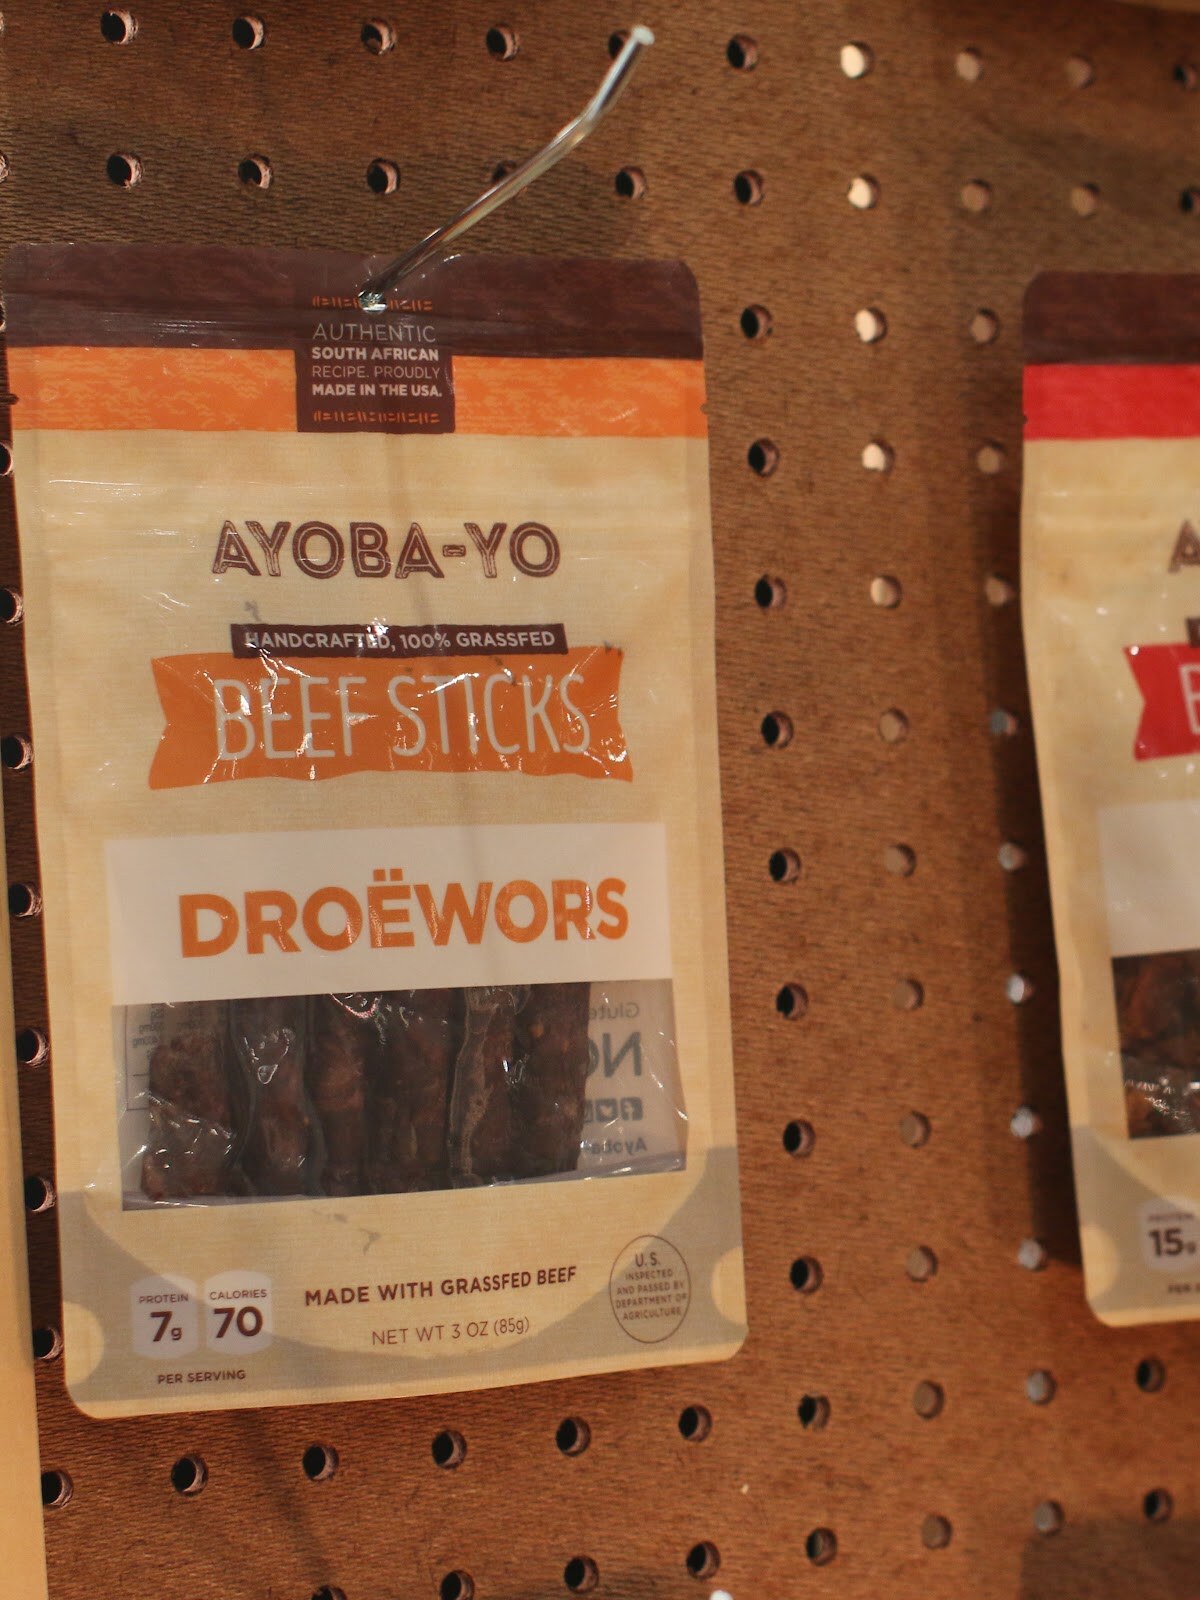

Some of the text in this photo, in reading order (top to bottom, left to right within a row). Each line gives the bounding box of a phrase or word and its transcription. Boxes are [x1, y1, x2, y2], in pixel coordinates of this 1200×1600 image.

[312, 323, 436, 343] AUTHENTIC
[312, 346, 439, 362] SOUTH AFRICAN
[312, 364, 441, 380] RECIPE. PROUDLY
[312, 383, 443, 398] MADE IN THE USA.
[211, 519, 562, 580] AYOBA-YO
[246, 631, 556, 652] HANDCRAFTED, 100% GRASSFED
[212, 673, 592, 761] BEEF STICKS
[178, 867, 631, 959] DROËWORS
[625, 1268, 674, 1281] INSPECTED
[304, 1265, 577, 1307] MADE WITH GRASSFED BEEF
[616, 1285, 635, 1295] AND
[638, 1281, 671, 1293] PASSED
[138, 1293, 189, 1304] PROTEIN
[209, 1288, 268, 1301] CALORIES
[615, 1294, 672, 1309] DEPARTMENT
[622, 1306, 682, 1320] AGRICULTURE
[149, 1310, 183, 1342] 7g
[212, 1305, 264, 1339] 70
[371, 1315, 531, 1346] NET WT 3 OZ (85g)
[157, 1369, 247, 1385] PER SERVING
